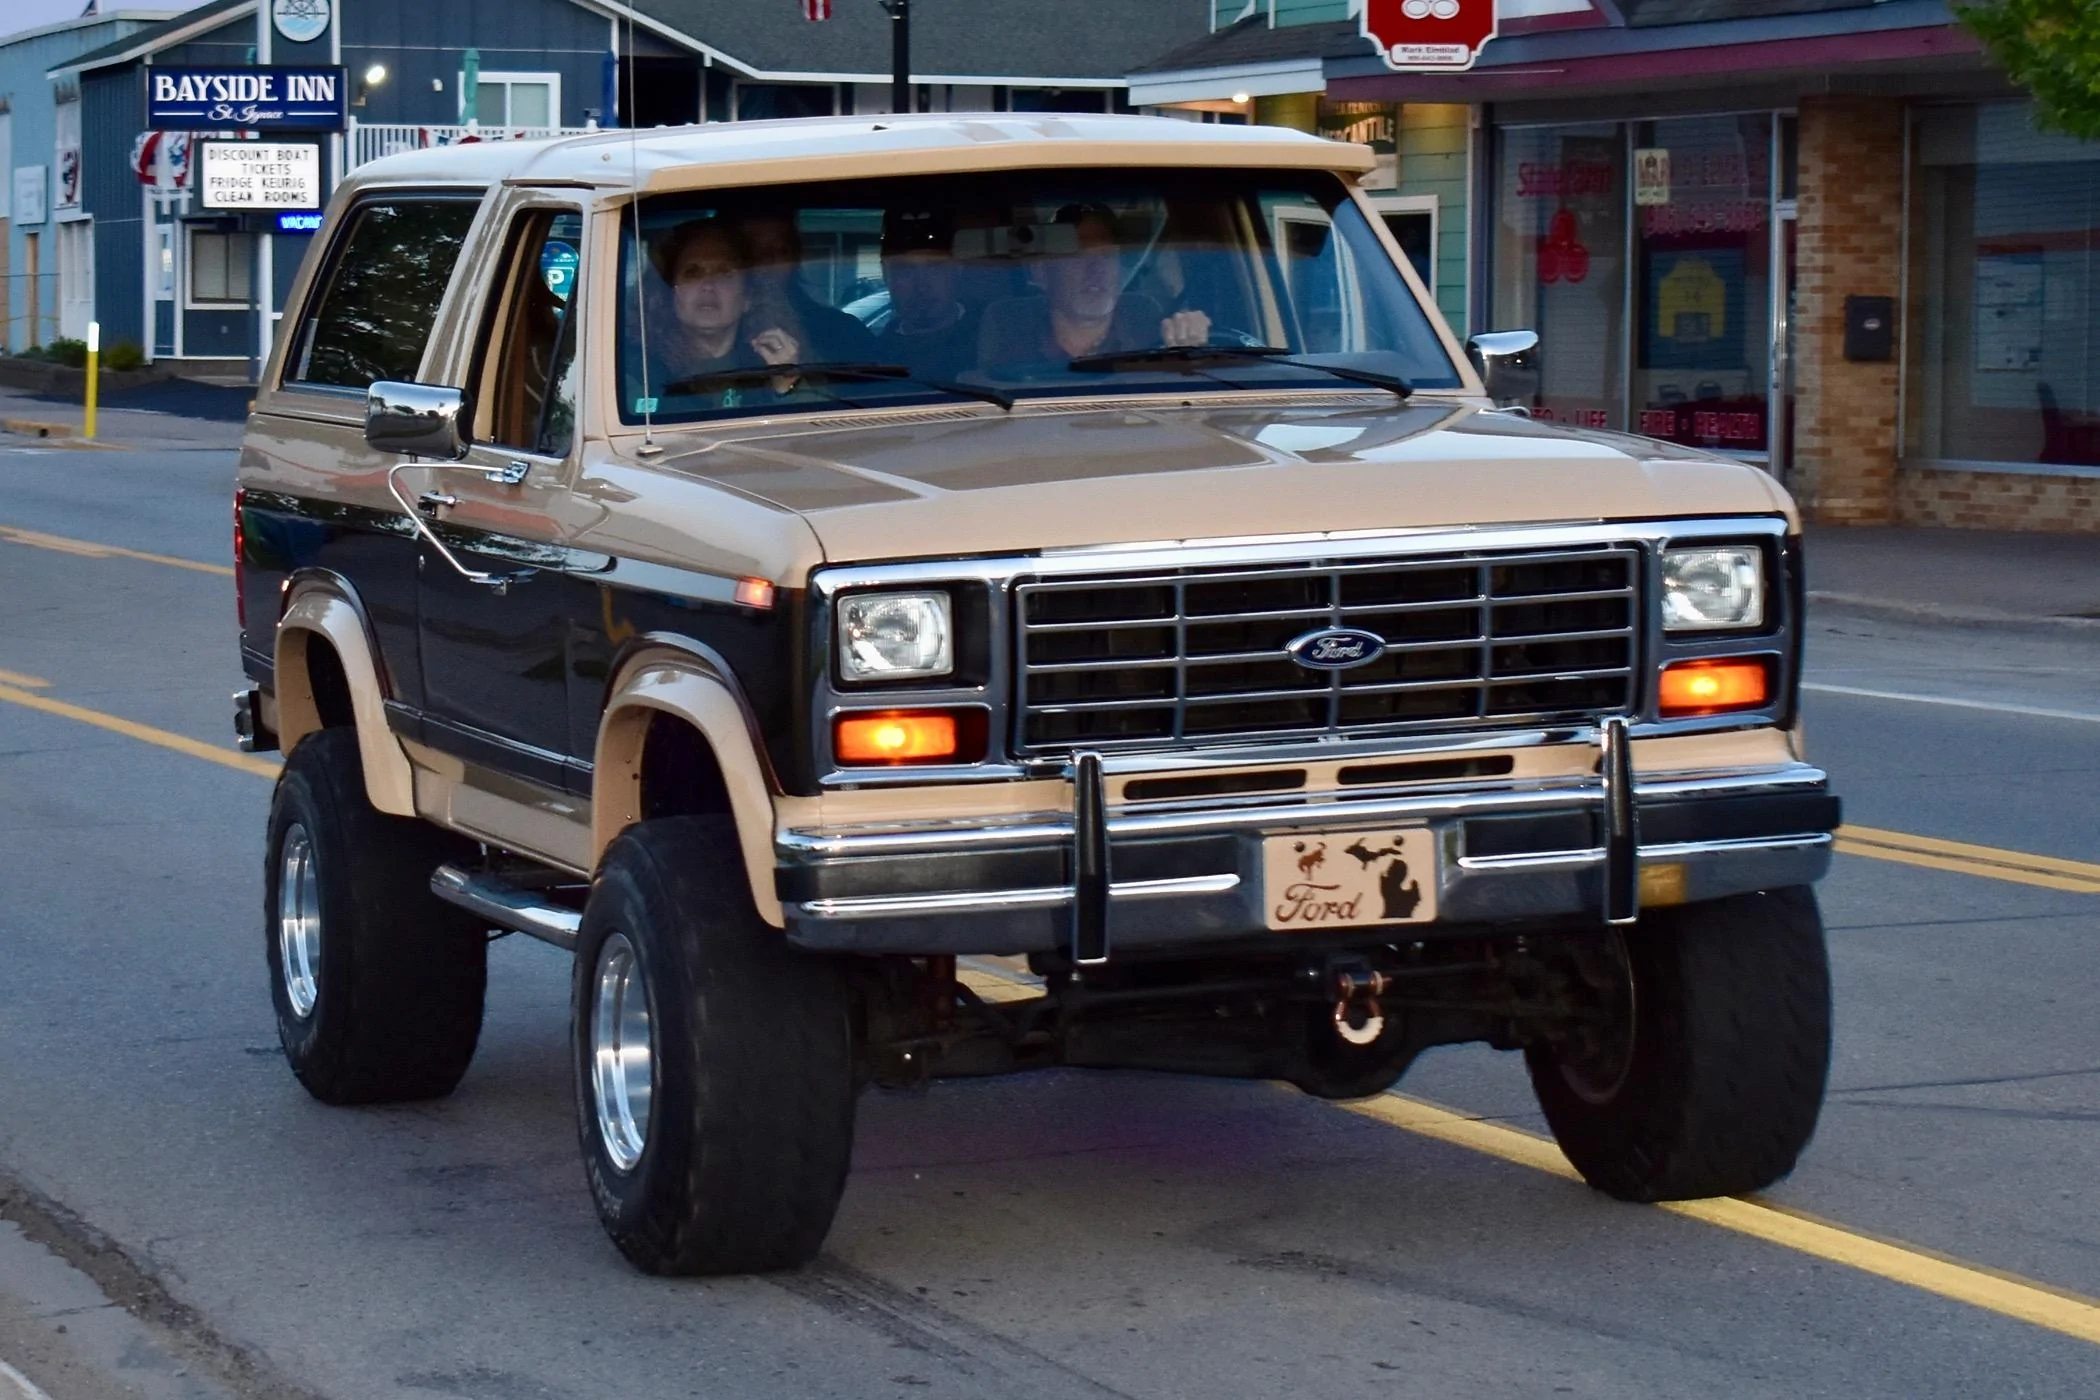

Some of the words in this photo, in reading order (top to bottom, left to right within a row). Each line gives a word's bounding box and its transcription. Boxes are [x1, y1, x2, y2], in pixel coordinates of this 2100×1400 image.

[155, 76, 278, 101] BAYSIDE
[287, 76, 335, 101] INN
[209, 149, 269, 160] DISCOUNT
[277, 149, 309, 160] BOAT
[242, 163, 292, 175] TICKETS
[210, 177, 253, 188] FRIDGE
[262, 177, 305, 188] KEURIG
[215, 191, 254, 202] CLEAN
[265, 191, 308, 203] ROOMS
[1312, 636, 1363, 659] Ford
[1275, 883, 1362, 922] Ford
